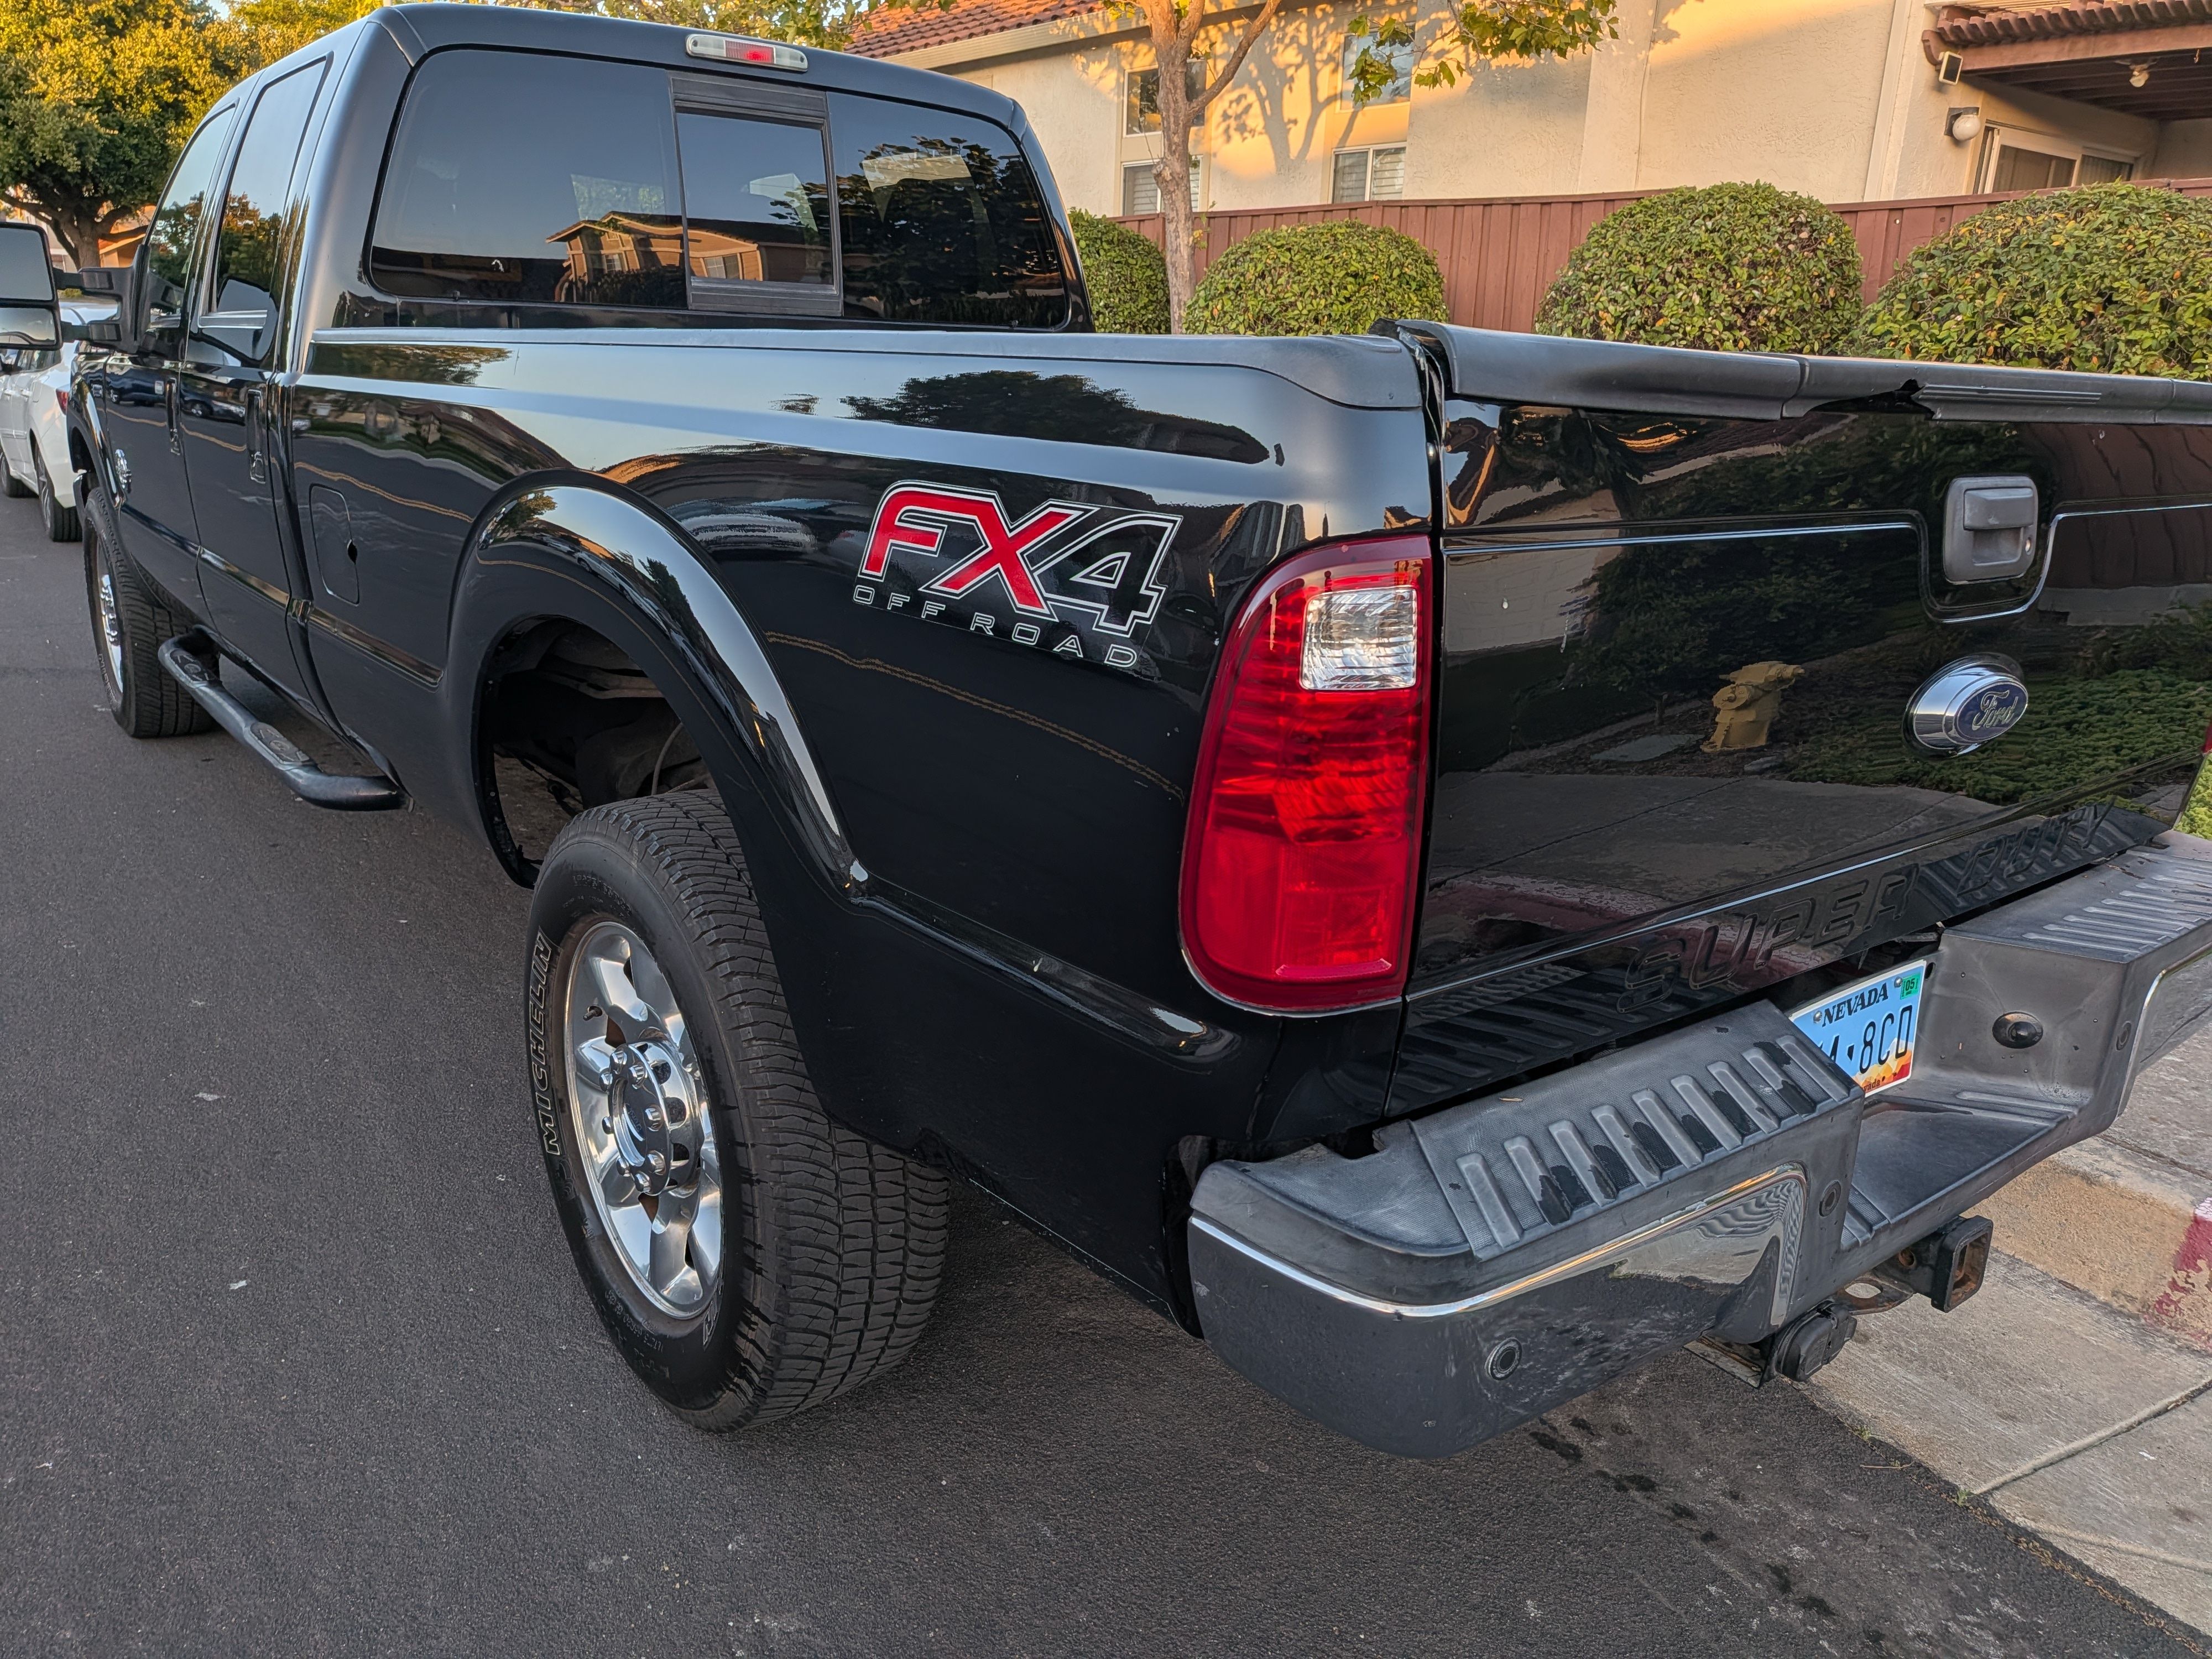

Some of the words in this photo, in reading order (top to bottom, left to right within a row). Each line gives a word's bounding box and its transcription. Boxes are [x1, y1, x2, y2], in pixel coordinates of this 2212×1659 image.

[858, 480, 1183, 638] FX4
[853, 585, 946, 619] OFF
[970, 612, 1138, 667] ROAD
[1971, 690, 2018, 731] Ford
[1617, 863, 1920, 1013] SUPER
[1822, 983, 1888, 1027] NEVADA
[1905, 978, 1916, 992] 05
[529, 925, 561, 1156] MICHELIN
